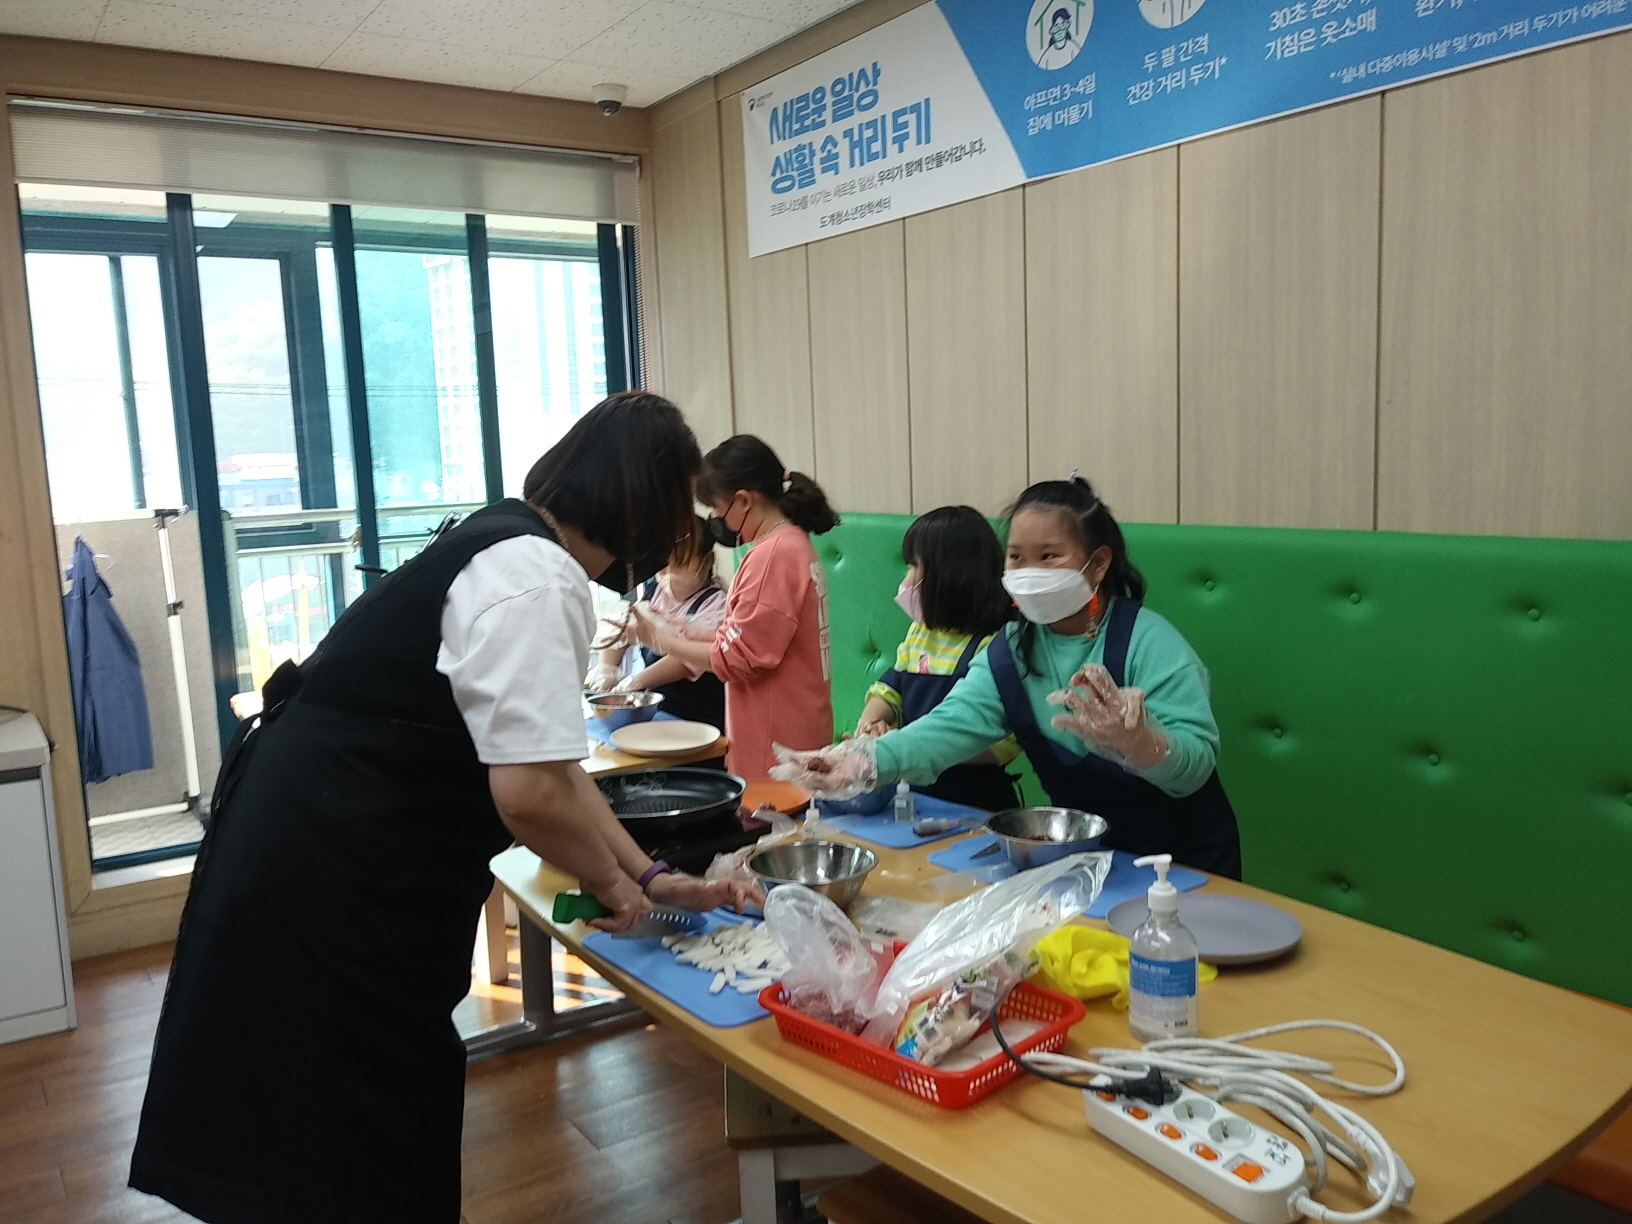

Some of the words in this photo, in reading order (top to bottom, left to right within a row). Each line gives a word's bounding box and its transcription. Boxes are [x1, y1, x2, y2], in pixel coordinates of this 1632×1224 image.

[1142, 51, 1159, 74] 두
[1161, 44, 1177, 69] 팔
[1178, 32, 1209, 63] 간격
[1264, 27, 1317, 60] 기침은
[1319, 6, 1377, 47] 옷소매
[1452, 34, 1468, 55] 및
[1498, 18, 1529, 40] 거리
[1531, 6, 1580, 33] 두기가
[769, 85, 827, 145] 새로운
[830, 60, 882, 124] 일상
[1023, 85, 1061, 112] 아프면
[1126, 78, 1155, 106] 건강
[1156, 67, 1186, 94] 거리
[1027, 111, 1053, 136] 집에
[1054, 99, 1093, 127] 머물기
[770, 141, 816, 195] 생활
[820, 134, 840, 177] 속
[843, 113, 887, 169] 거리
[891, 96, 931, 154] 두기
[877, 163, 904, 186] 우리가
[904, 157, 924, 178] 함께
[924, 136, 987, 172] 만들어갑니다.
